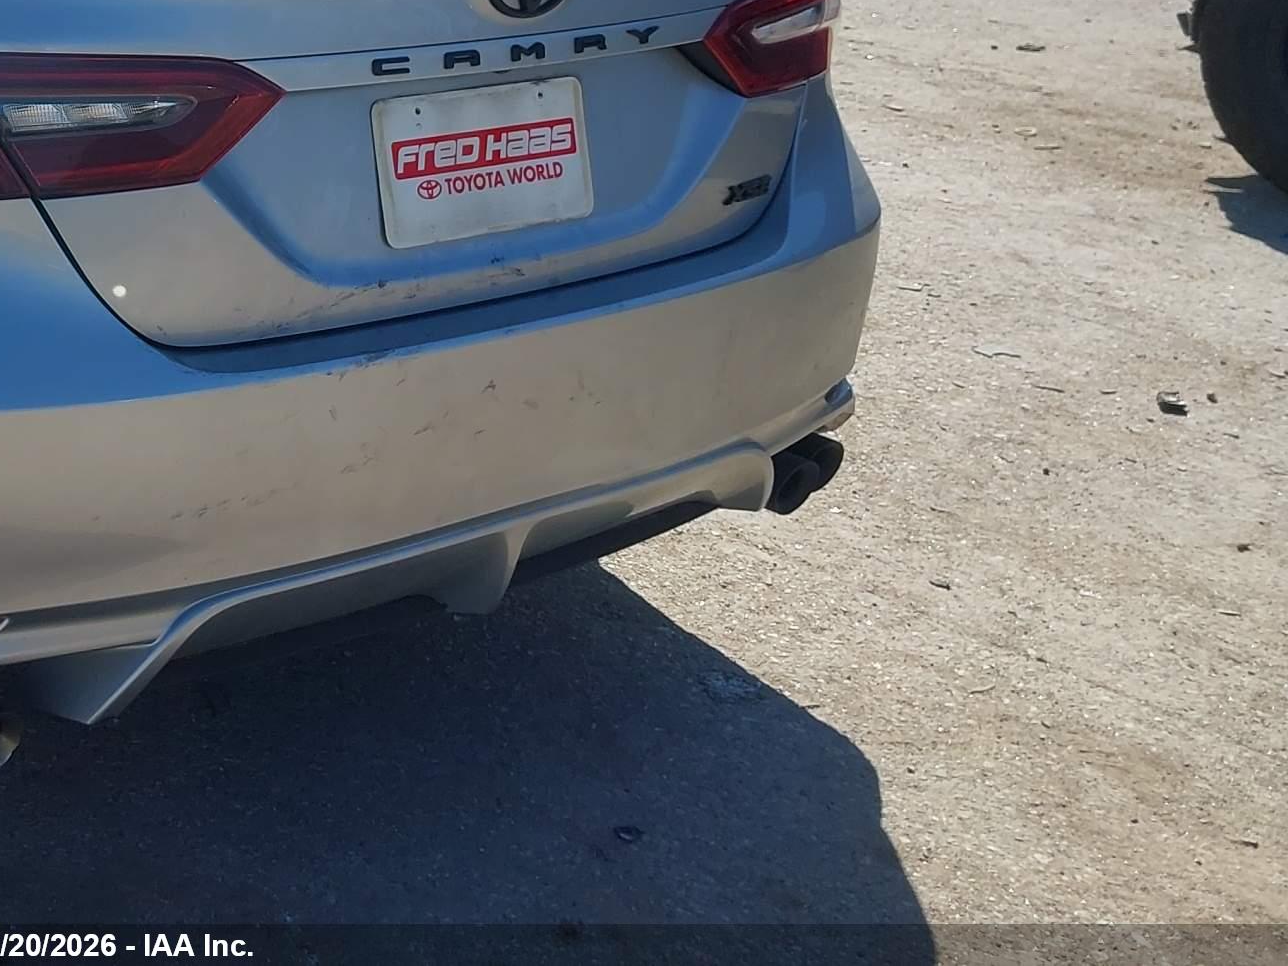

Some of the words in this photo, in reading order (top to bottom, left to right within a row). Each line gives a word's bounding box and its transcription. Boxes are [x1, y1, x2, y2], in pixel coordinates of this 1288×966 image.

[371, 25, 660, 76] CAMRY
[445, 171, 505, 195] TOYOTA
[507, 161, 563, 184] WORLD
